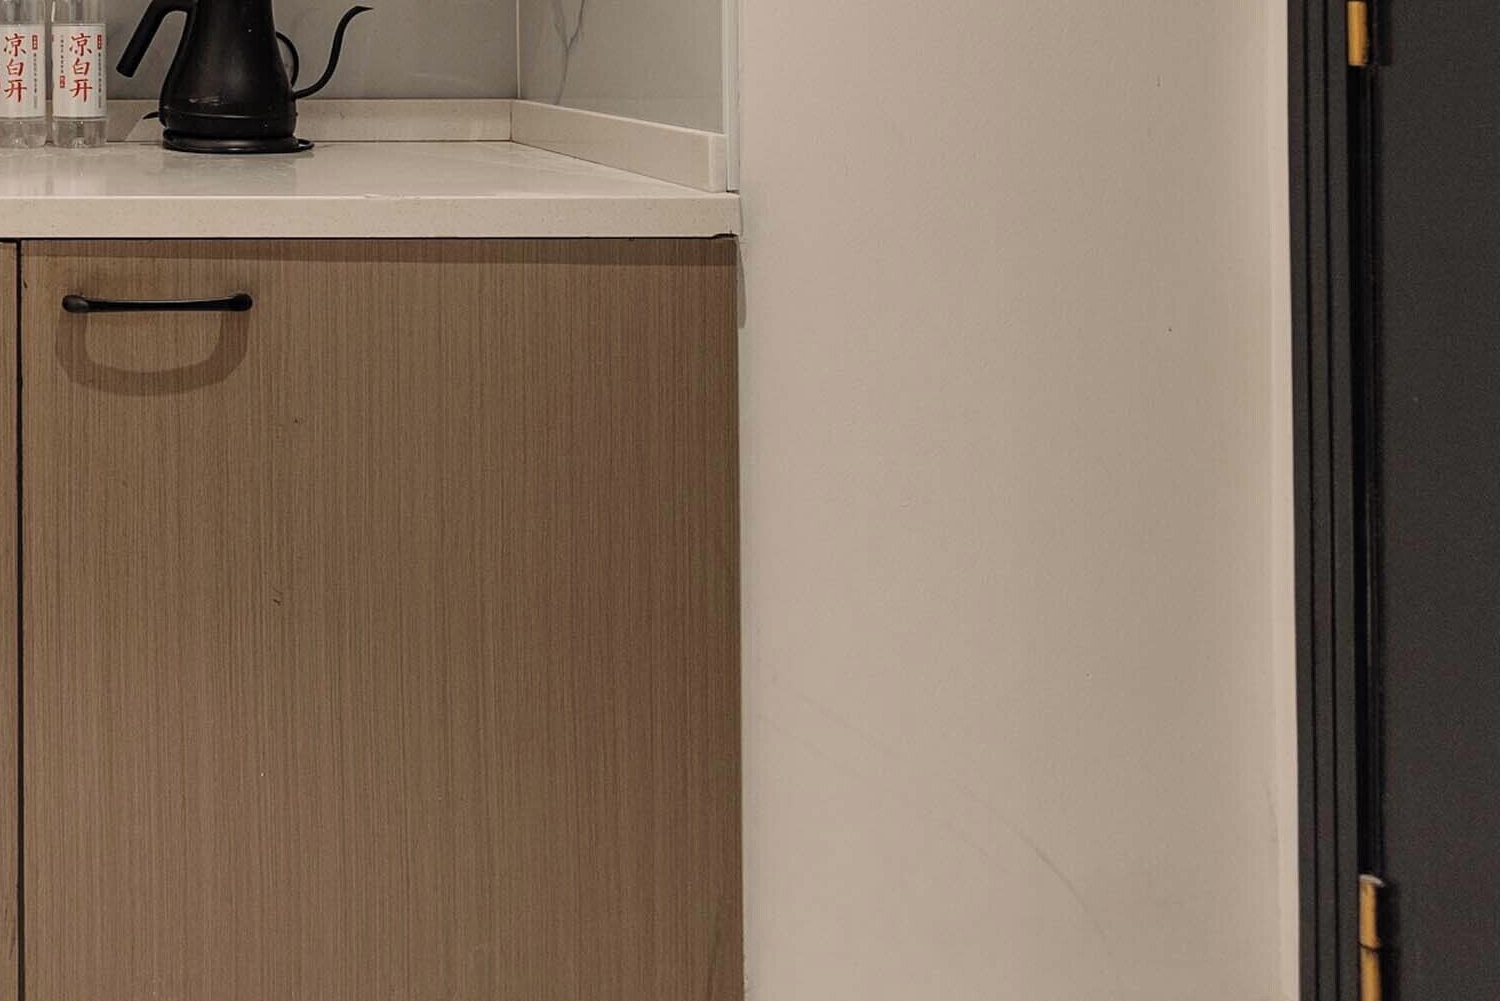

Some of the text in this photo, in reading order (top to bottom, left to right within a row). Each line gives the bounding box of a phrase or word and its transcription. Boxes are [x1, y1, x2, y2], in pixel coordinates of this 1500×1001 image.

[3, 33, 28, 103] 凉白开
[69, 32, 93, 103] 凉白开
